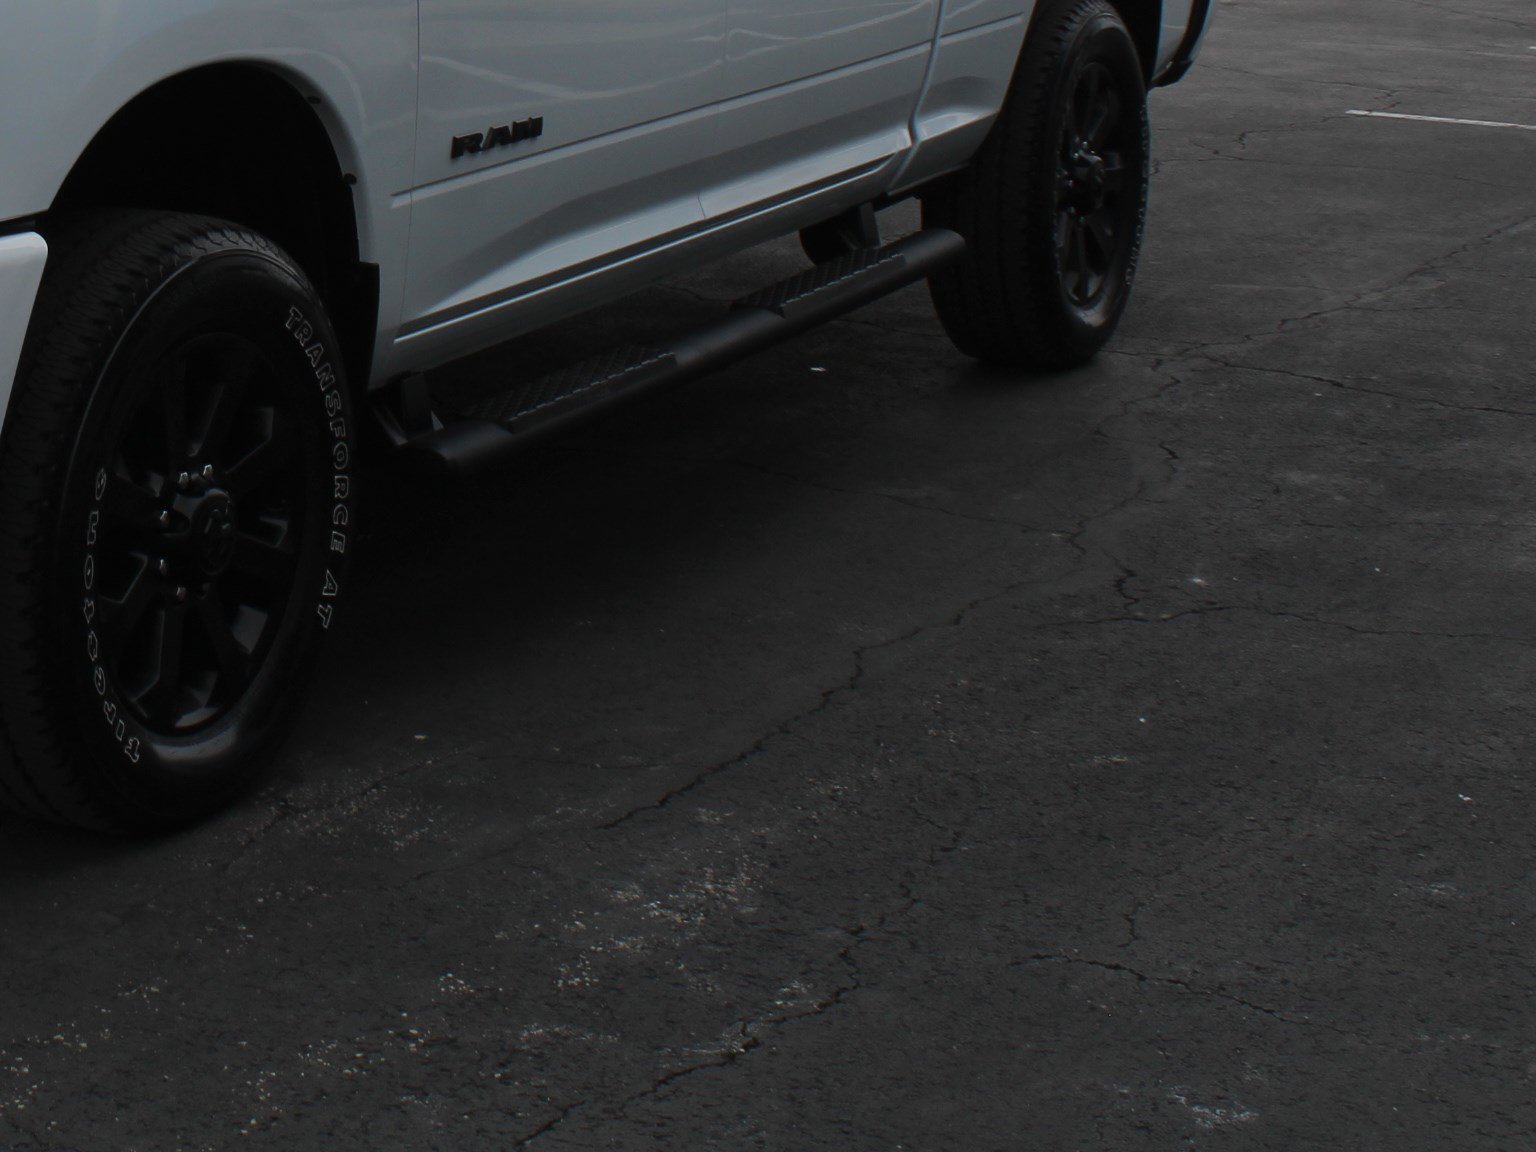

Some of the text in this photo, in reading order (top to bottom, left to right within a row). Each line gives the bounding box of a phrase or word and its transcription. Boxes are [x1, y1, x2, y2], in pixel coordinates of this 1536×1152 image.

[450, 116, 544, 160] RAM
[285, 306, 349, 630] TRANSFORCE AT
